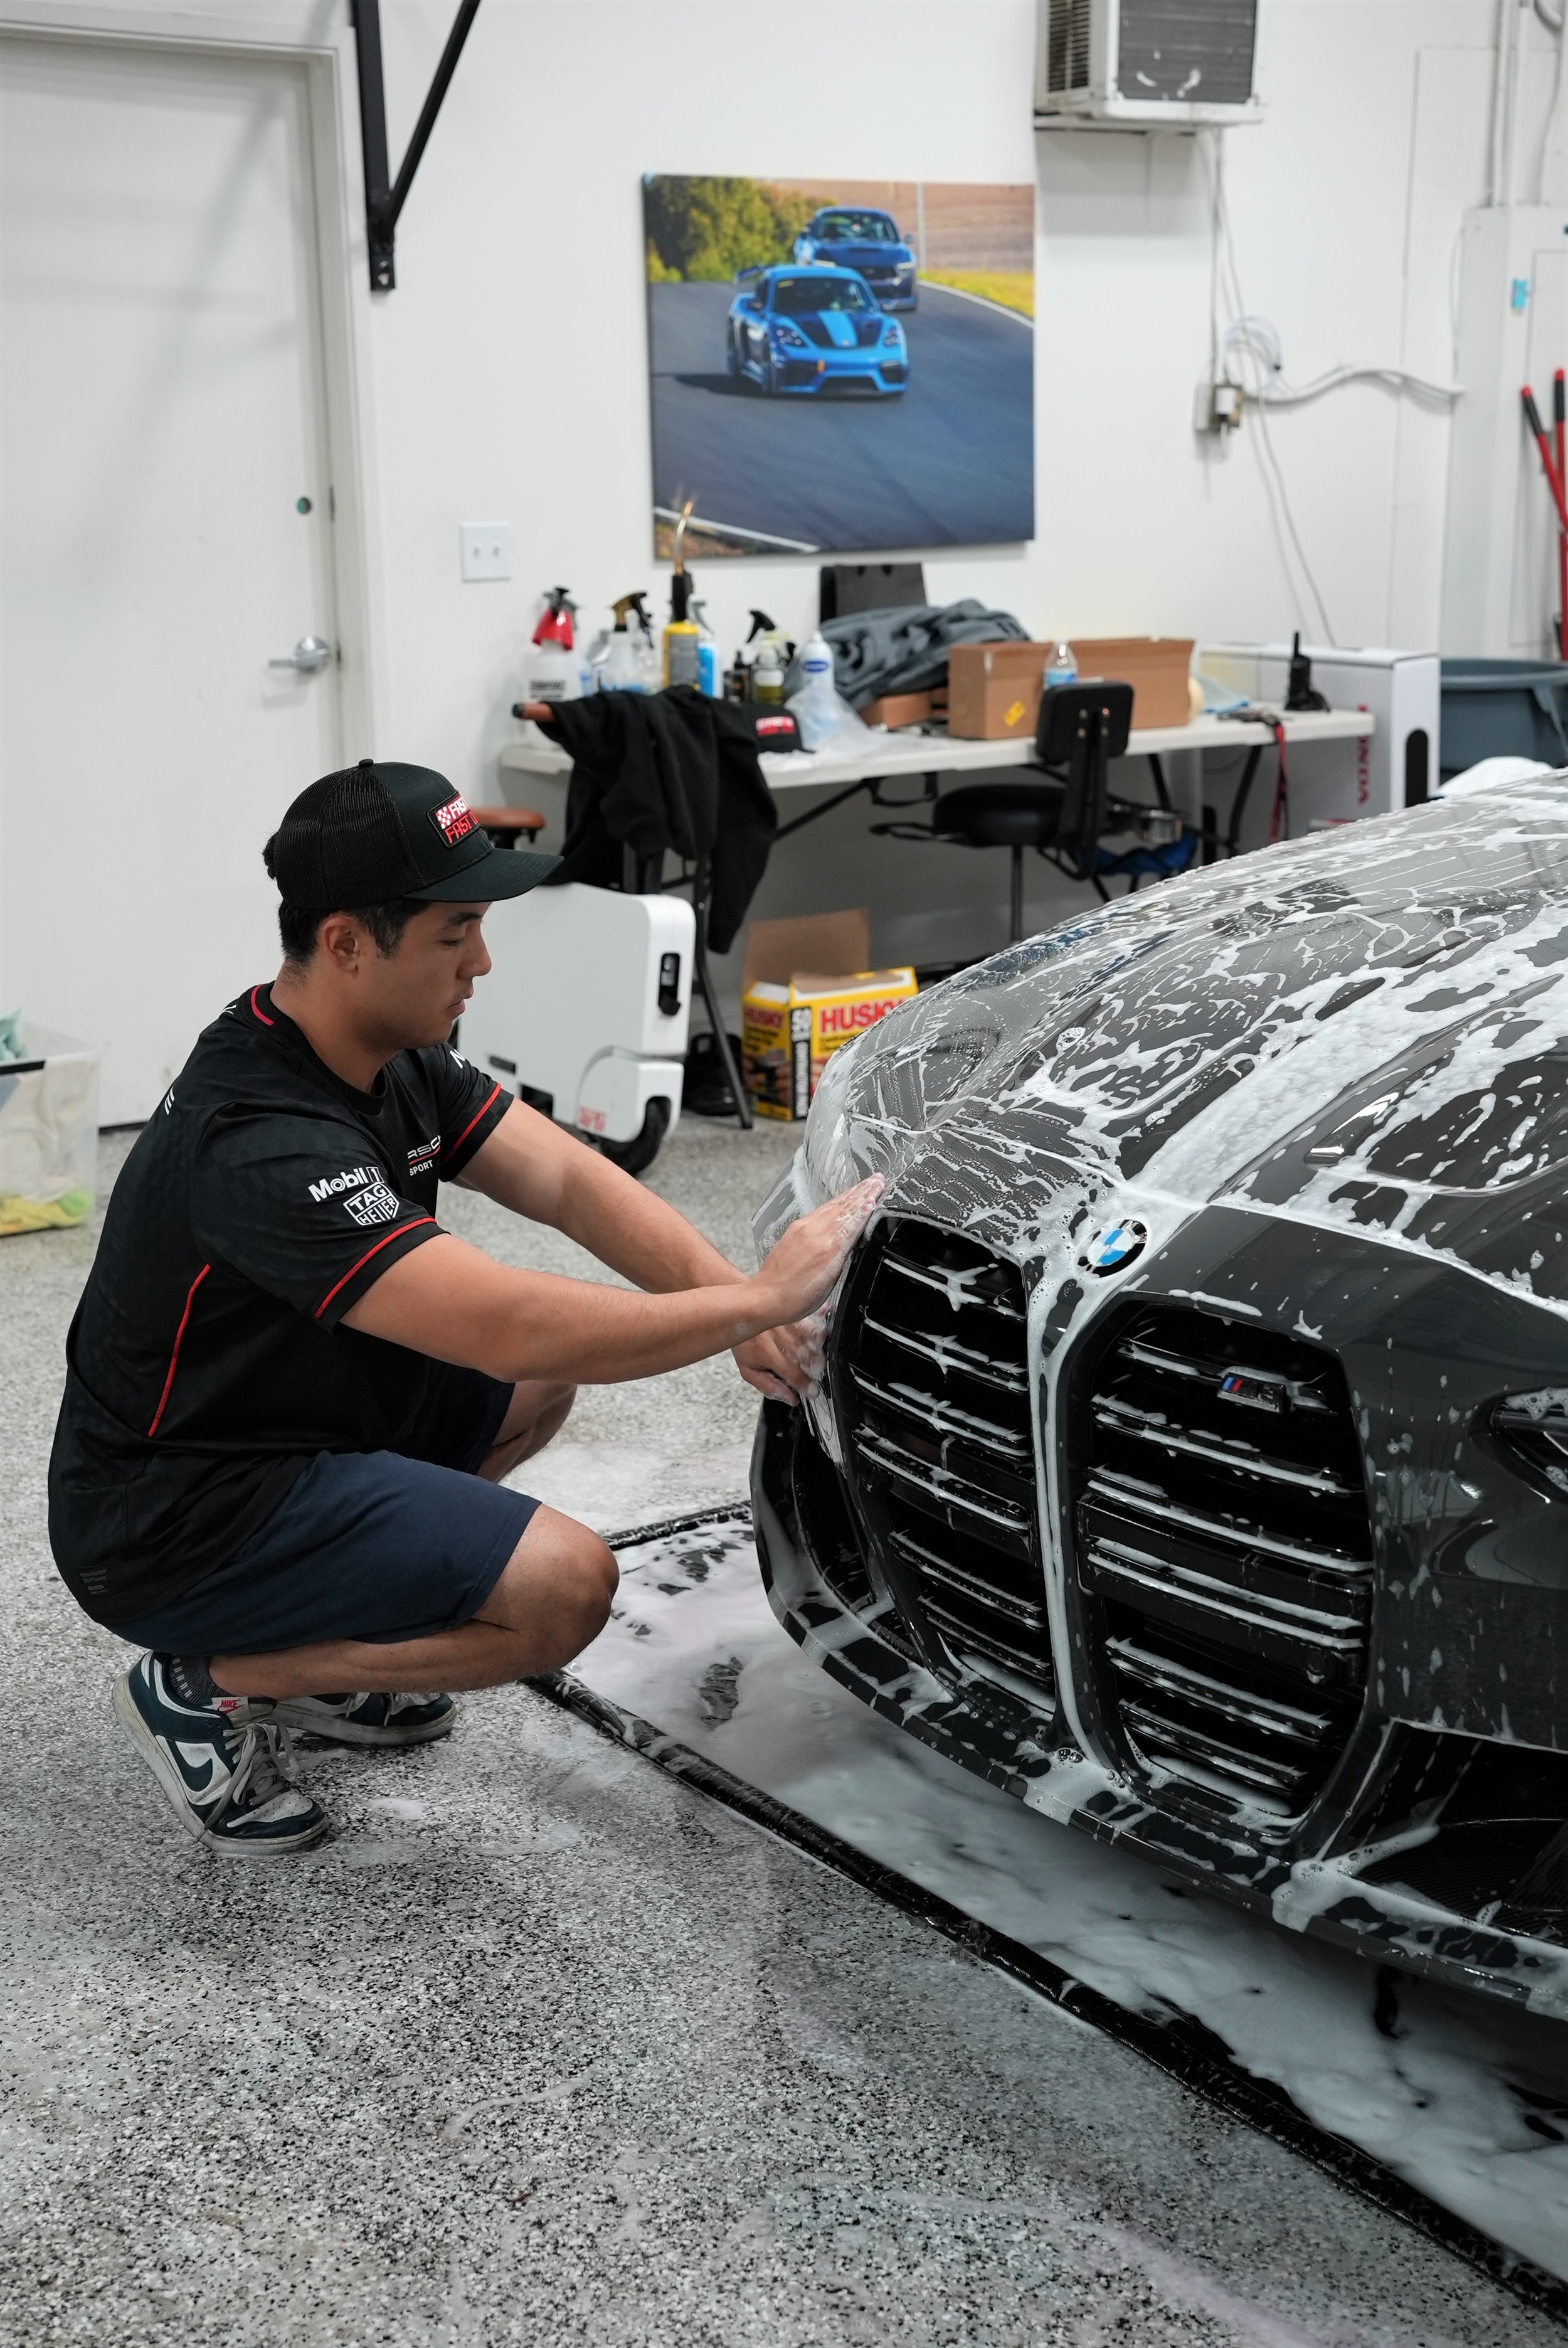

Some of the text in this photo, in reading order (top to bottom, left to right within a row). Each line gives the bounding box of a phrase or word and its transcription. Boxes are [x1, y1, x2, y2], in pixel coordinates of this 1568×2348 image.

[444, 814, 472, 844] FAST
[308, 1167, 369, 1202] Mobil
[349, 1184, 387, 1211] TAG
[220, 1699, 238, 1708] NIKE
